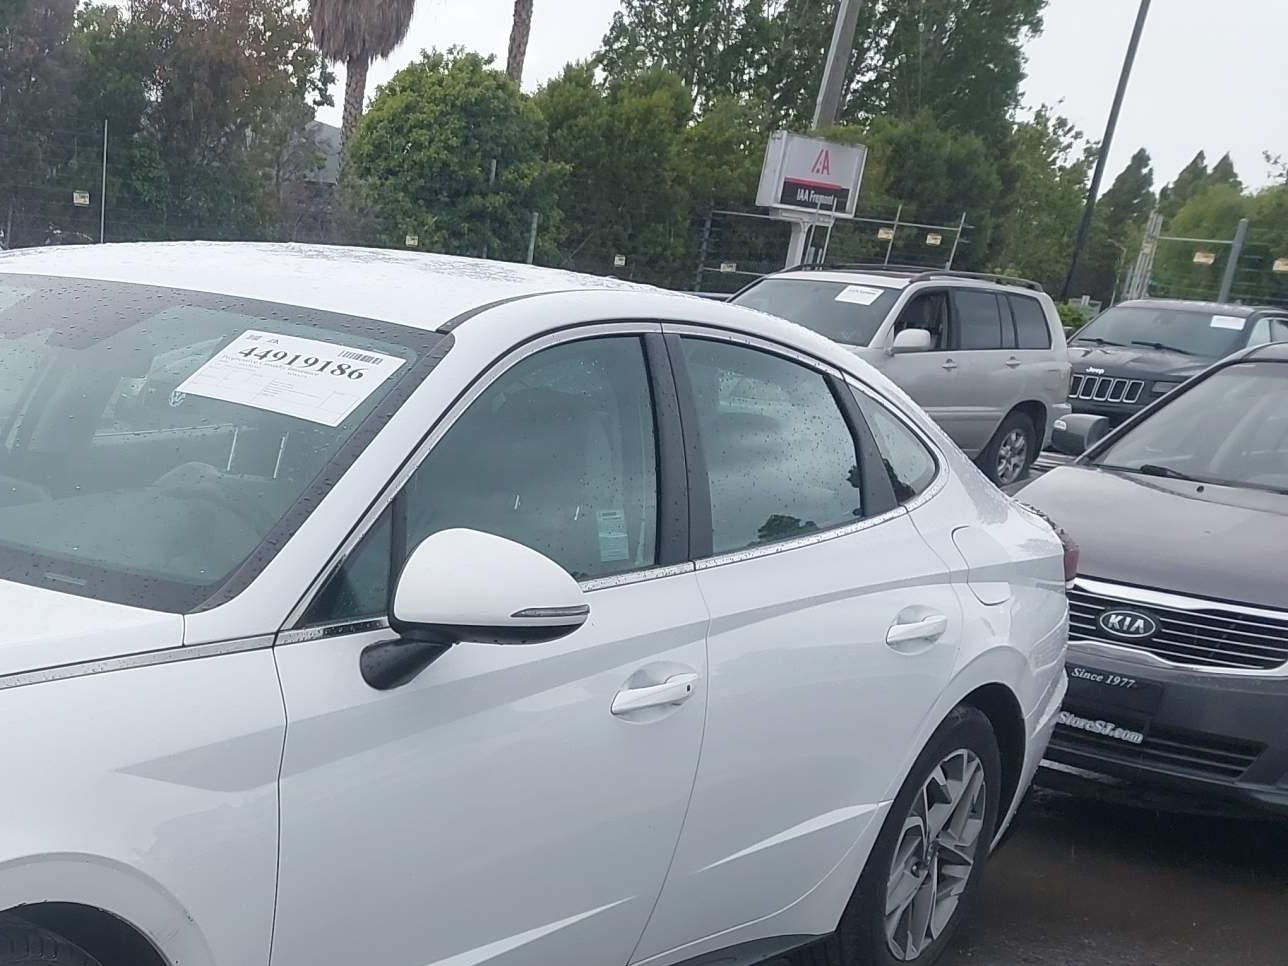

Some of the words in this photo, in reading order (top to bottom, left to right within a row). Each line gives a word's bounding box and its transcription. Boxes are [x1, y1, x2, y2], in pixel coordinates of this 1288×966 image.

[796, 188, 809, 201] IAA
[238, 346, 368, 381] 44919186
[1107, 614, 1145, 634] KIA
[1071, 667, 1104, 682] Since
[1105, 675, 1136, 689] 1977
